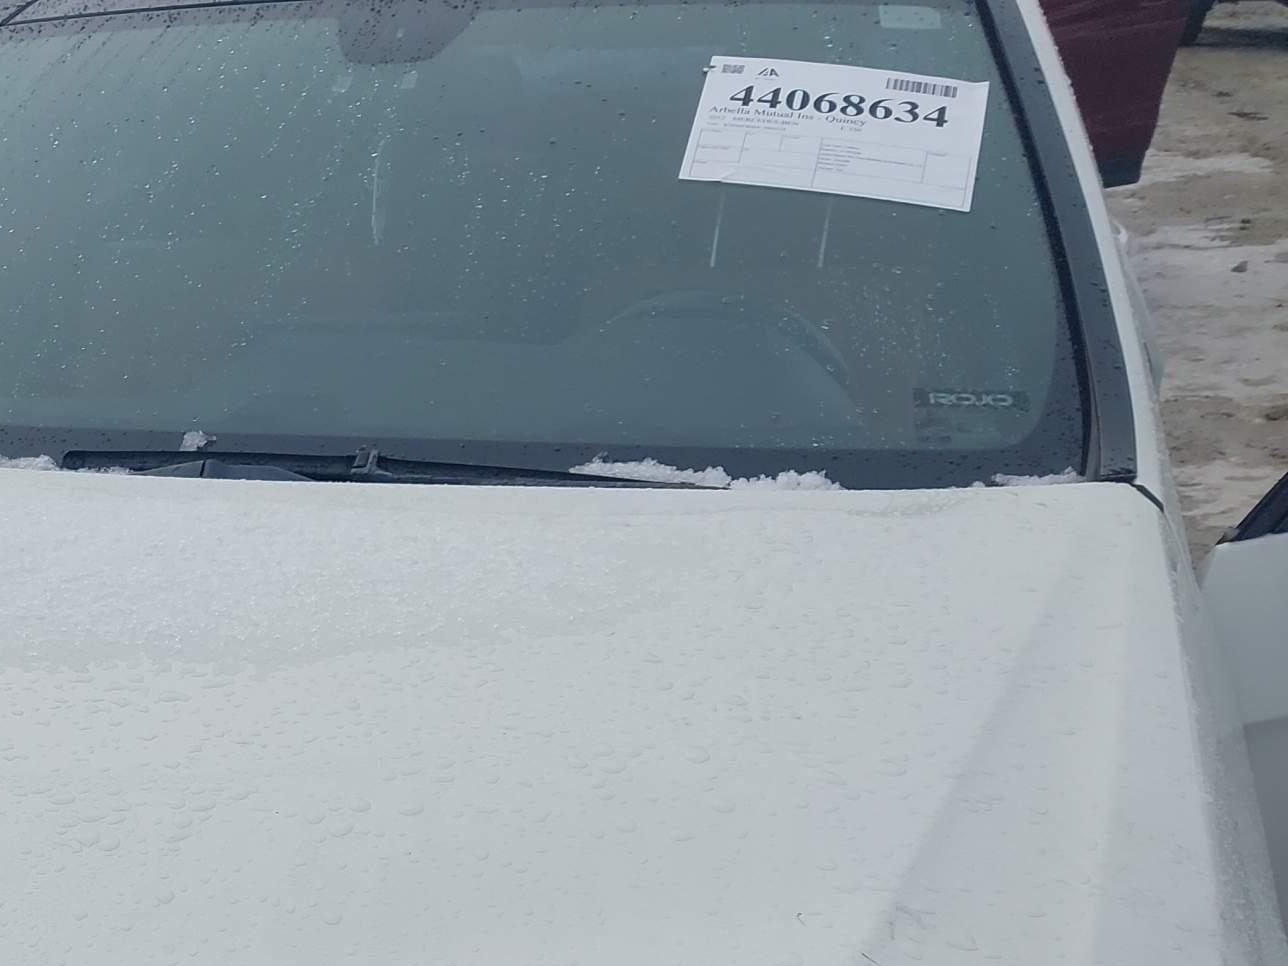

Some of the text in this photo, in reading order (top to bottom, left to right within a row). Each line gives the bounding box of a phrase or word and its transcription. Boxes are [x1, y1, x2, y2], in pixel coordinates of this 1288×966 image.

[709, 105, 751, 116] Arbella
[753, 109, 794, 119] Mutual
[825, 115, 867, 126] Quincy
[729, 84, 949, 128] 44068634
